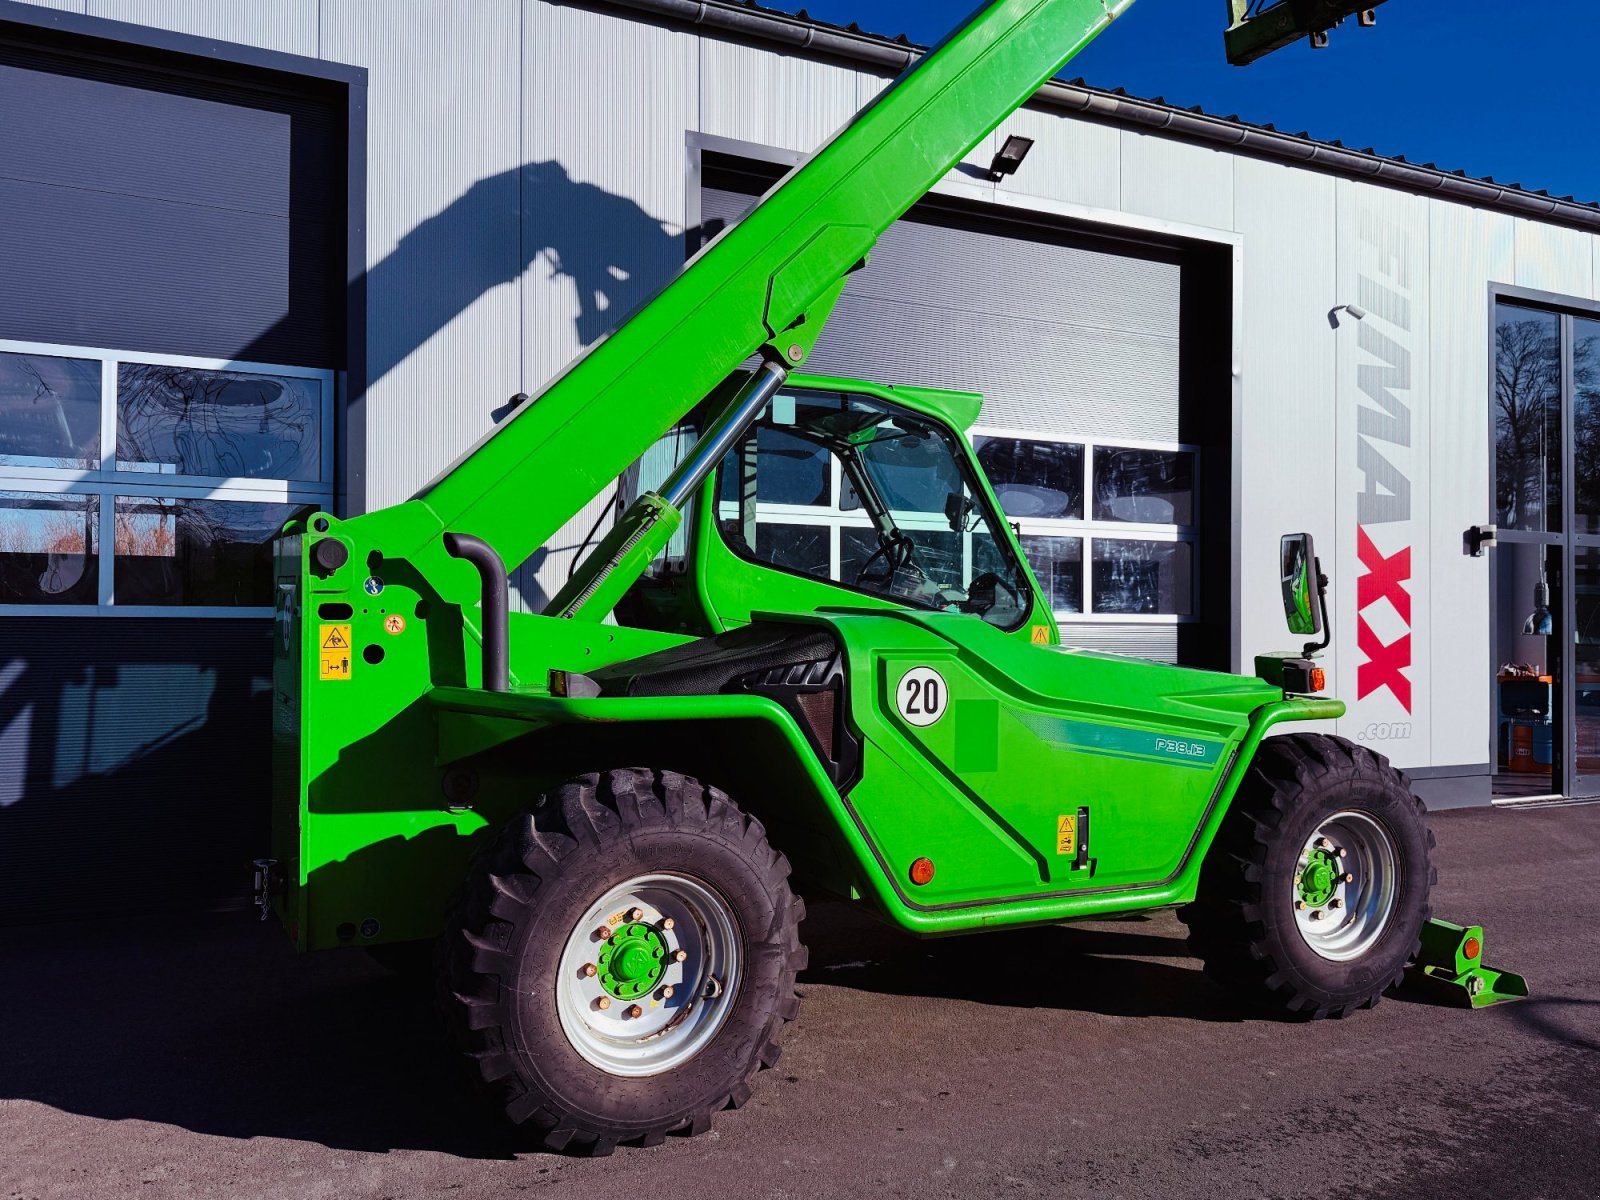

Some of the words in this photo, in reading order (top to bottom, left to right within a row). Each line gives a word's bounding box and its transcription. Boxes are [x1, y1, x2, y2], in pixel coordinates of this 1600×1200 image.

[1357, 207, 1411, 715] FIMAXX
[906, 678, 939, 715] 20
[1357, 722, 1412, 741] .com
[1155, 738, 1206, 757] P38.13
